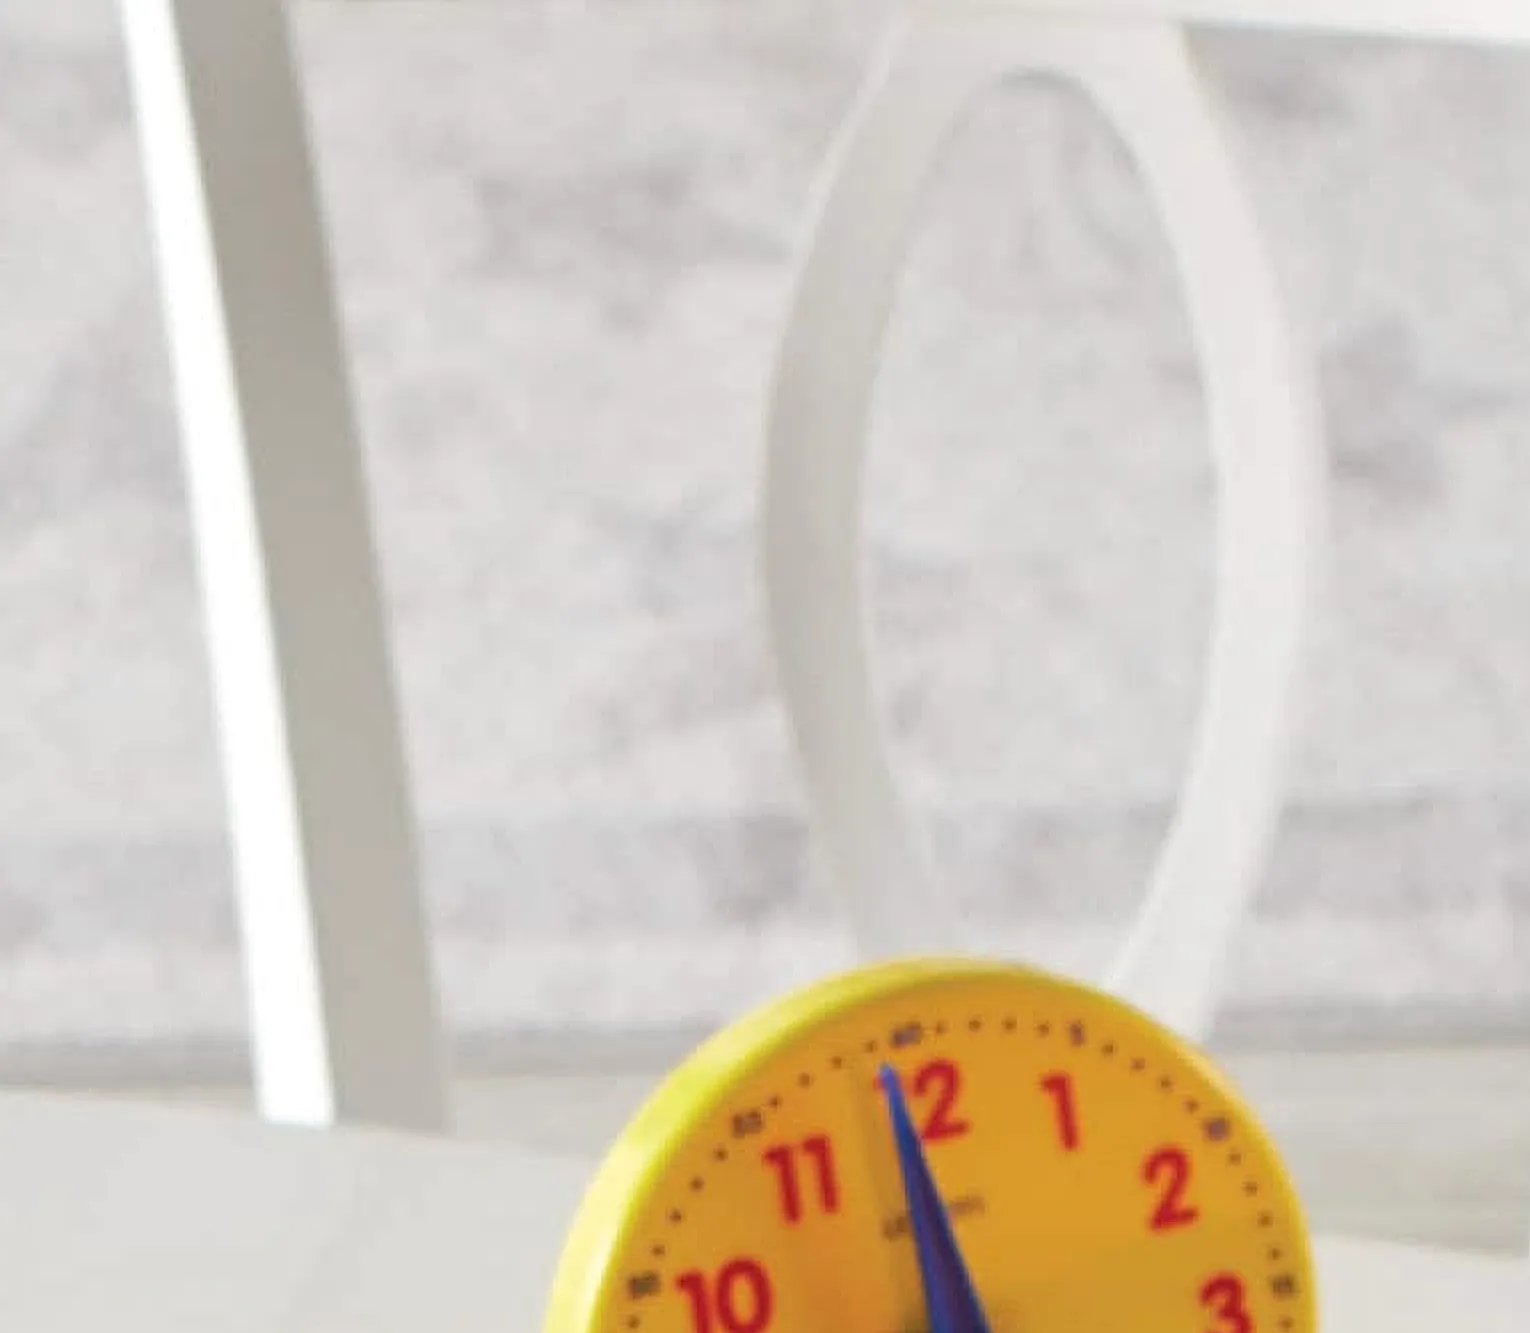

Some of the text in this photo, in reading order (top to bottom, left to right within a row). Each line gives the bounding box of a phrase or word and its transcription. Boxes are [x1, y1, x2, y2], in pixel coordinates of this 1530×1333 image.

[874, 1057, 969, 1144] 2
[1040, 1073, 1079, 1151] 1
[762, 1134, 840, 1225] 11
[1142, 1146, 1199, 1232] 2
